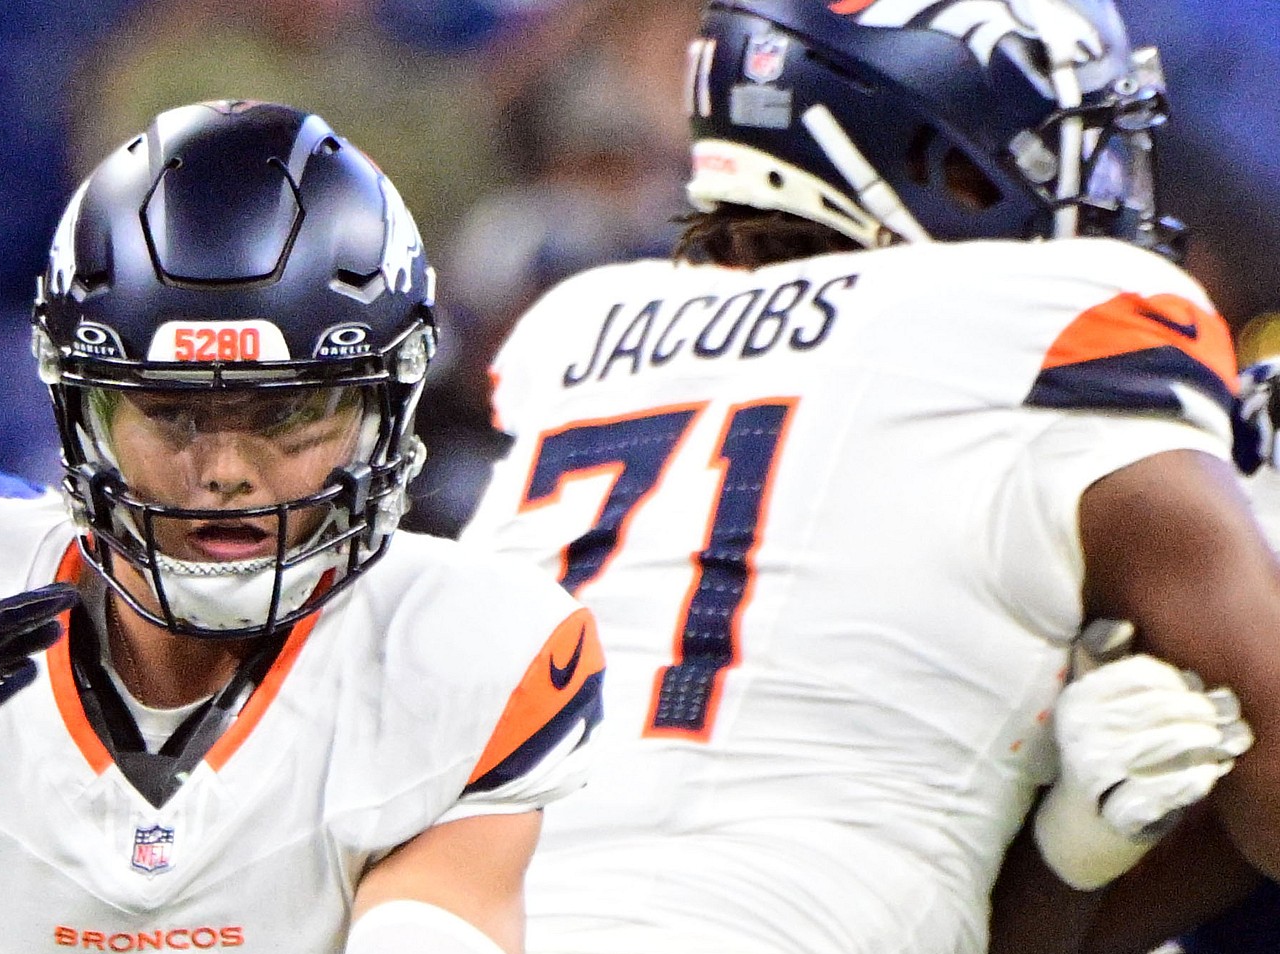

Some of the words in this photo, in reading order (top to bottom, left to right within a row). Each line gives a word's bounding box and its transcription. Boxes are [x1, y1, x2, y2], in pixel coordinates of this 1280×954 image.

[174, 327, 260, 361] 5280
[563, 274, 860, 390] JACOBS
[73, 341, 115, 356] OAKLEY
[320, 343, 371, 356] OAKLEY
[519, 396, 801, 742] 71
[54, 925, 245, 953] BRONCOS
